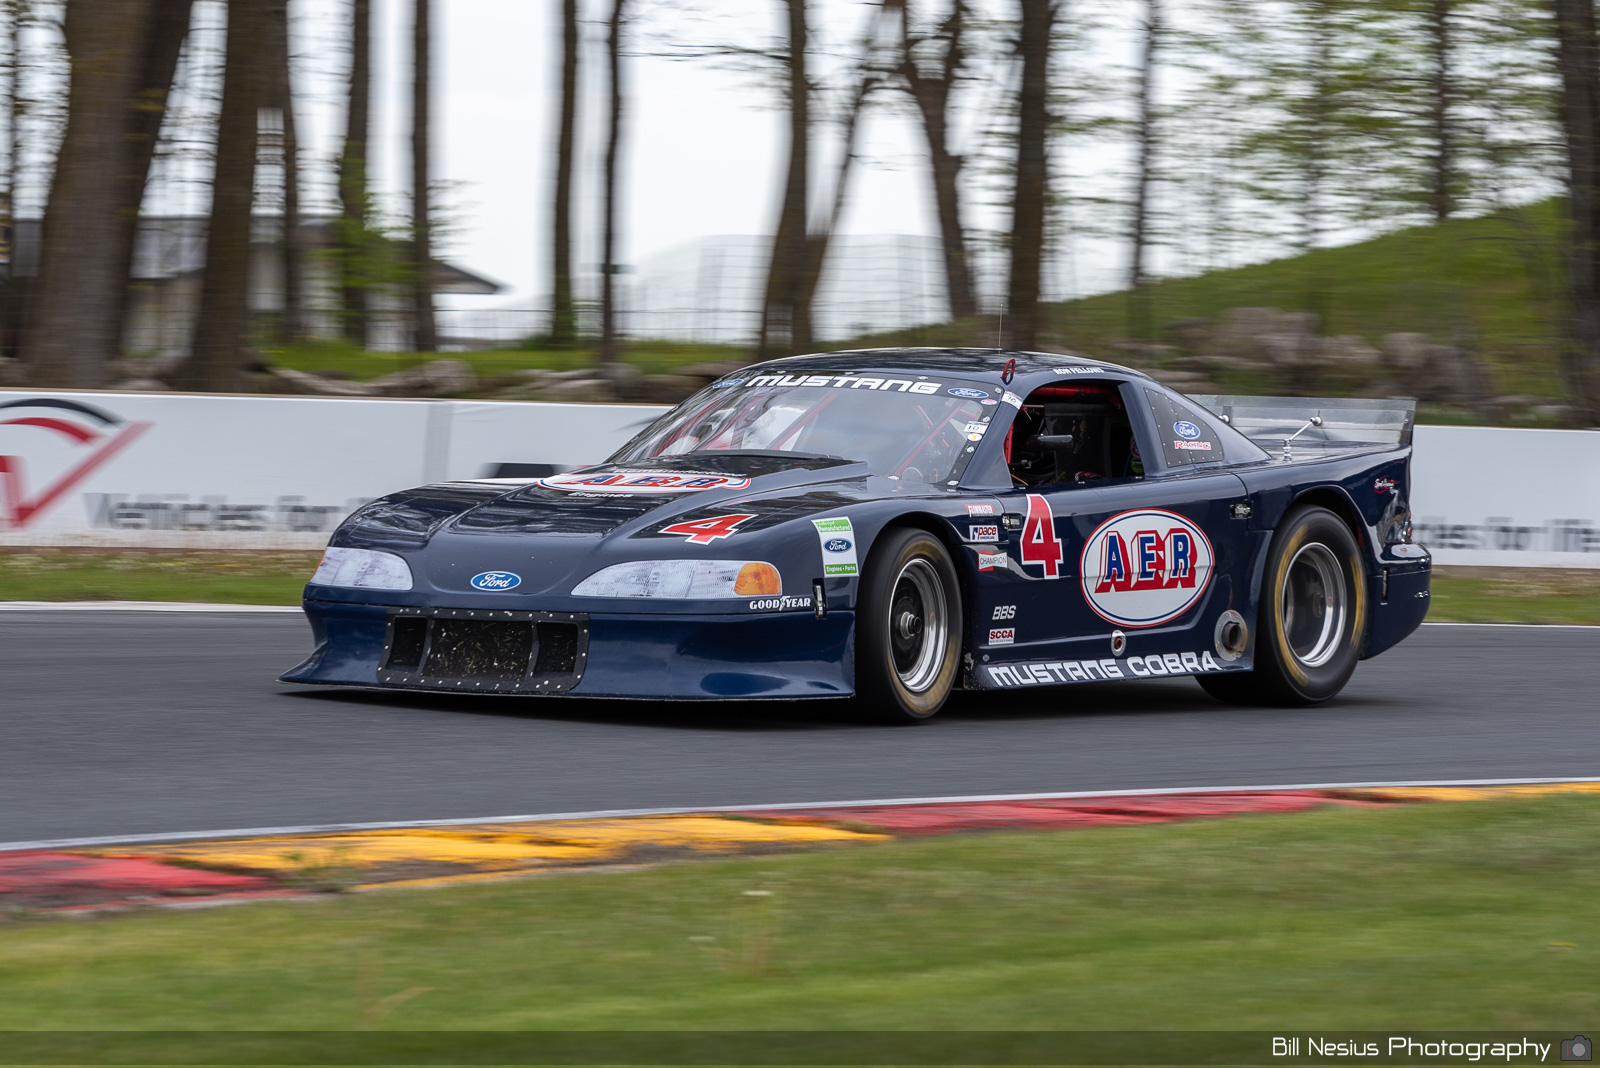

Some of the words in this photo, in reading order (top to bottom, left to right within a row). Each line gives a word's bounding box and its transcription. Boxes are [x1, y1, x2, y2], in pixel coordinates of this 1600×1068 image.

[1070, 366, 1105, 374] FELLOWS
[745, 375, 942, 394] MUSTANG
[1177, 422, 1197, 437] Ford
[1174, 441, 1212, 450] RACING
[555, 473, 729, 488] AER
[658, 513, 758, 545] 4
[977, 527, 997, 541] pace
[1020, 494, 1064, 579] 4
[828, 540, 848, 552] Ford
[979, 556, 1007, 566] CHAMPION
[1095, 528, 1198, 593] AER
[826, 565, 843, 573] Engines
[477, 573, 514, 589] Ford
[749, 595, 812, 611] GOODYEAR
[992, 604, 1017, 620] BBS
[989, 629, 1014, 640] SCCA
[987, 658, 1124, 686] MUSTANG
[1126, 650, 1223, 676] COBRA
